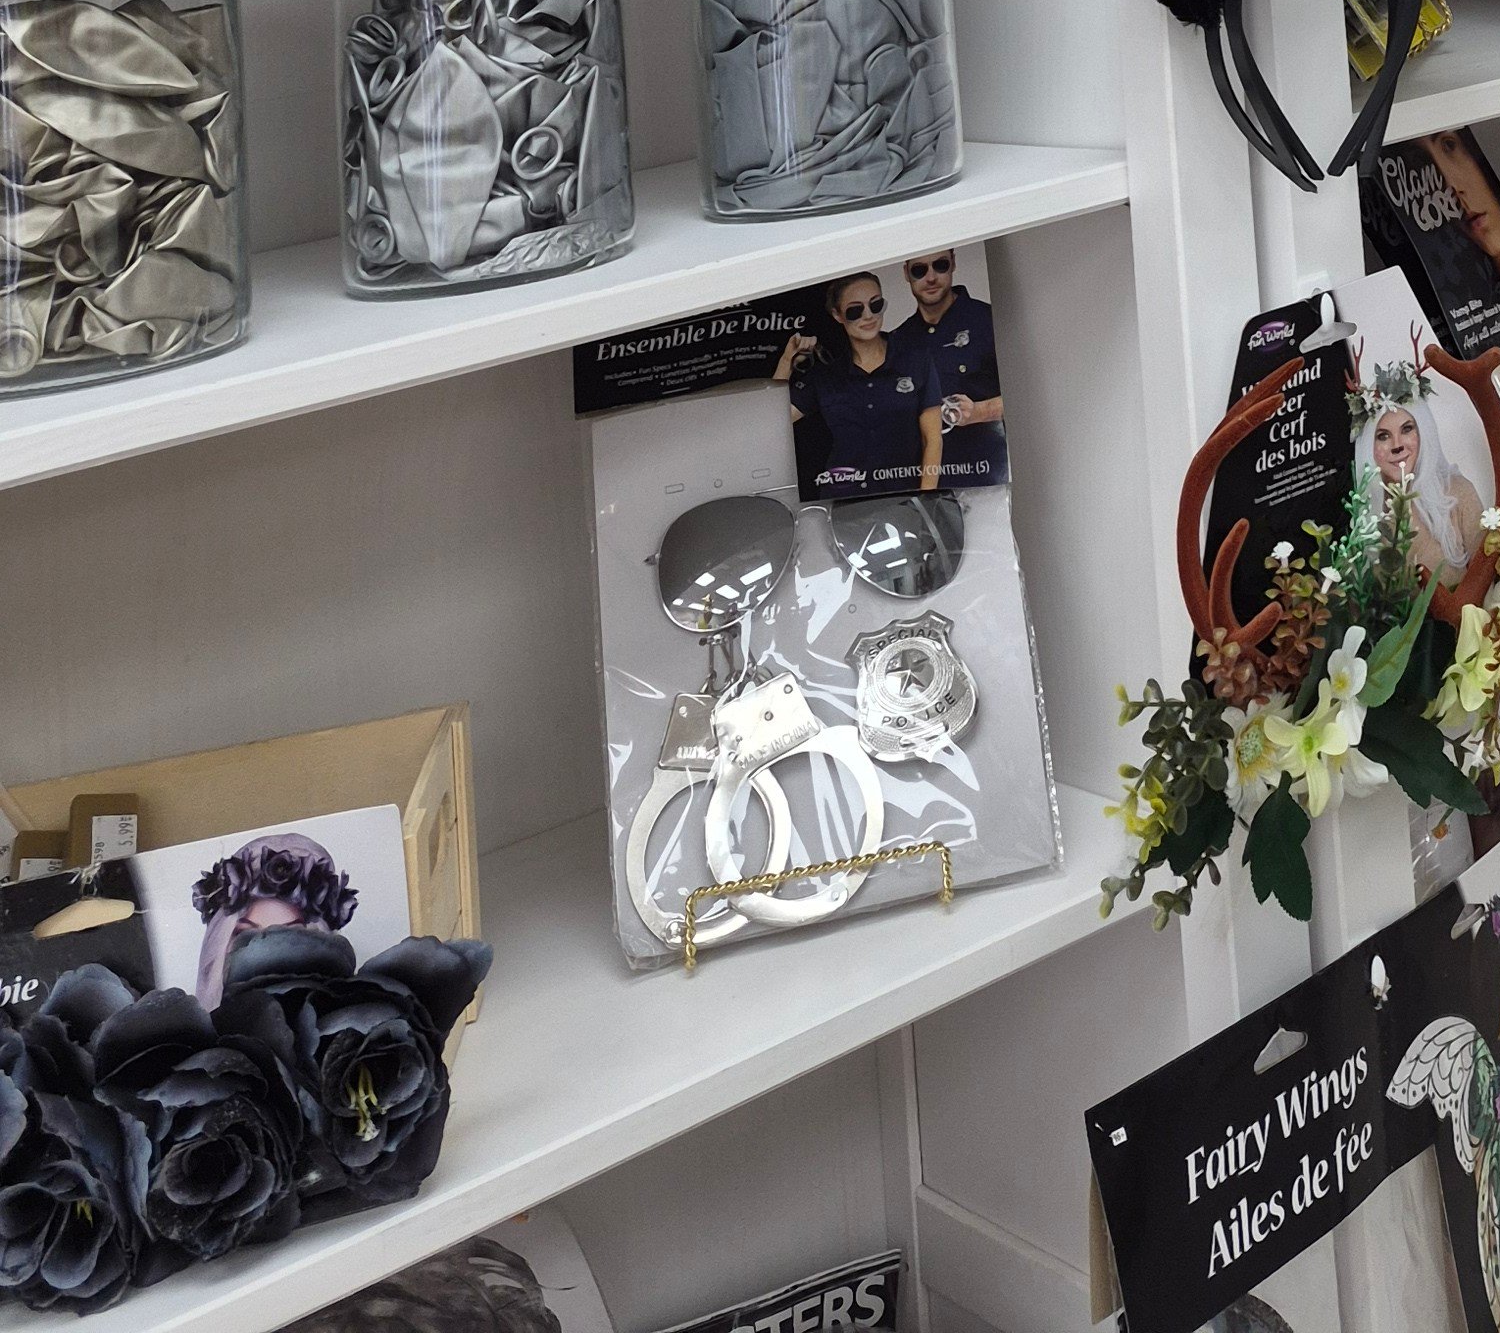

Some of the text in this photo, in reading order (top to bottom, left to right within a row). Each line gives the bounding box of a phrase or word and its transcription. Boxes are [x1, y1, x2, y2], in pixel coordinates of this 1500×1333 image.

[595, 311, 807, 362] Ensemble De Police
[1269, 409, 1308, 443] Cerf
[814, 459, 990, 485] fun World CONTENTS/CONTENU: (5)
[1255, 430, 1327, 474] des bois
[867, 627, 938, 660] SPECIAL
[881, 689, 957, 729] POICE
[737, 745, 770, 770] MADE
[780, 720, 816, 751] CHINA
[1185, 1045, 1370, 1206] Fairy Wings
[1206, 1121, 1375, 1280] Ailes de fée
